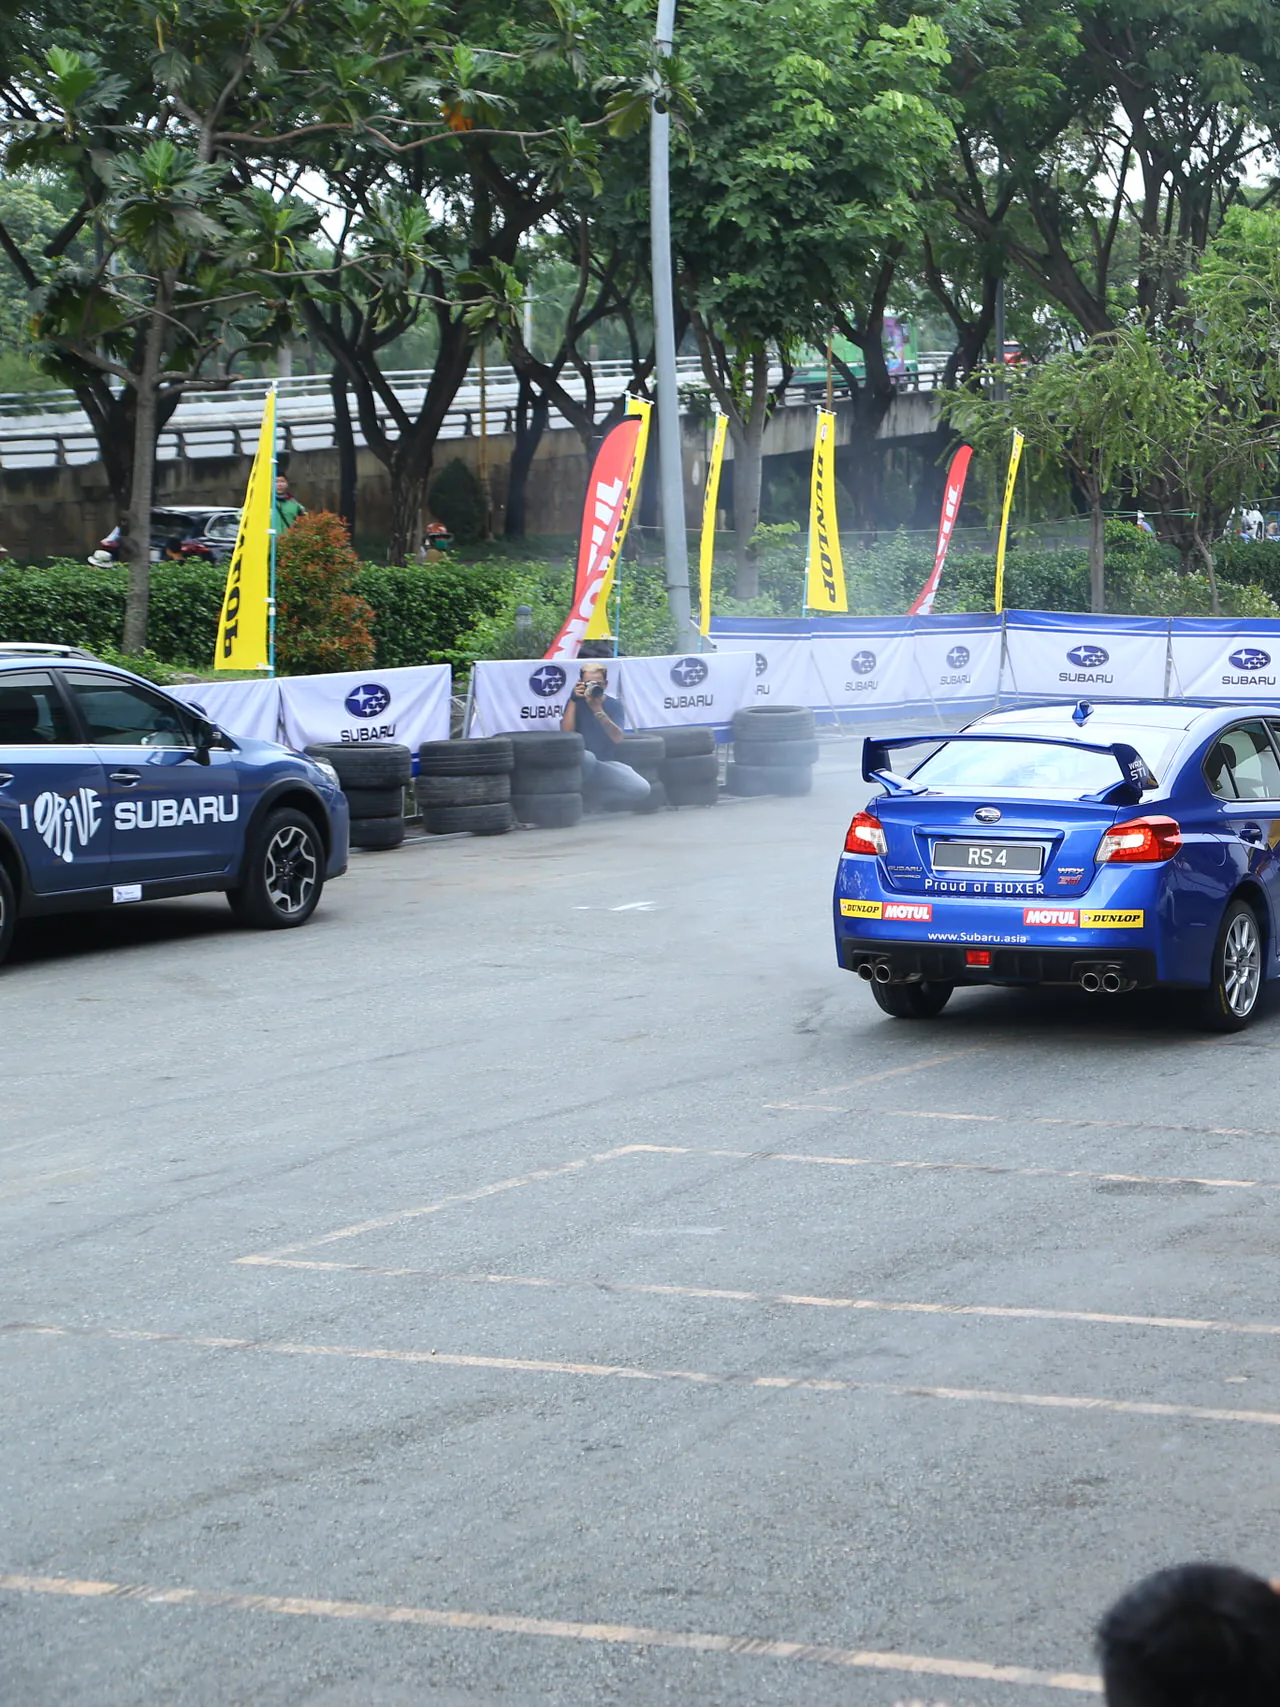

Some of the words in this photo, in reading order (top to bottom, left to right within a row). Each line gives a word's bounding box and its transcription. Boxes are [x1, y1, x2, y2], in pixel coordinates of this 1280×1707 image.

[815, 452, 837, 604] DUNLOP
[940, 674, 971, 685] SUBARU
[1058, 672, 1114, 684] SUBARU
[1222, 675, 1276, 686] SUBARU
[844, 680, 879, 692] SUBARU
[663, 694, 714, 709] SUBARU
[340, 724, 396, 743] SUBARU
[1128, 760, 1143, 770] WRX
[1130, 767, 1147, 781] STI
[20, 803, 29, 830] I
[114, 794, 239, 831] SUBARU
[925, 879, 967, 892] Proud
[973, 881, 988, 893] of
[994, 883, 1045, 895] BOXER
[846, 903, 880, 914] DUNLOP
[884, 904, 930, 920] MOTUL
[1026, 911, 1077, 925] MOTUL
[1092, 914, 1140, 923] DUNLOP
[928, 932, 1028, 944] www.Subaru.asia
